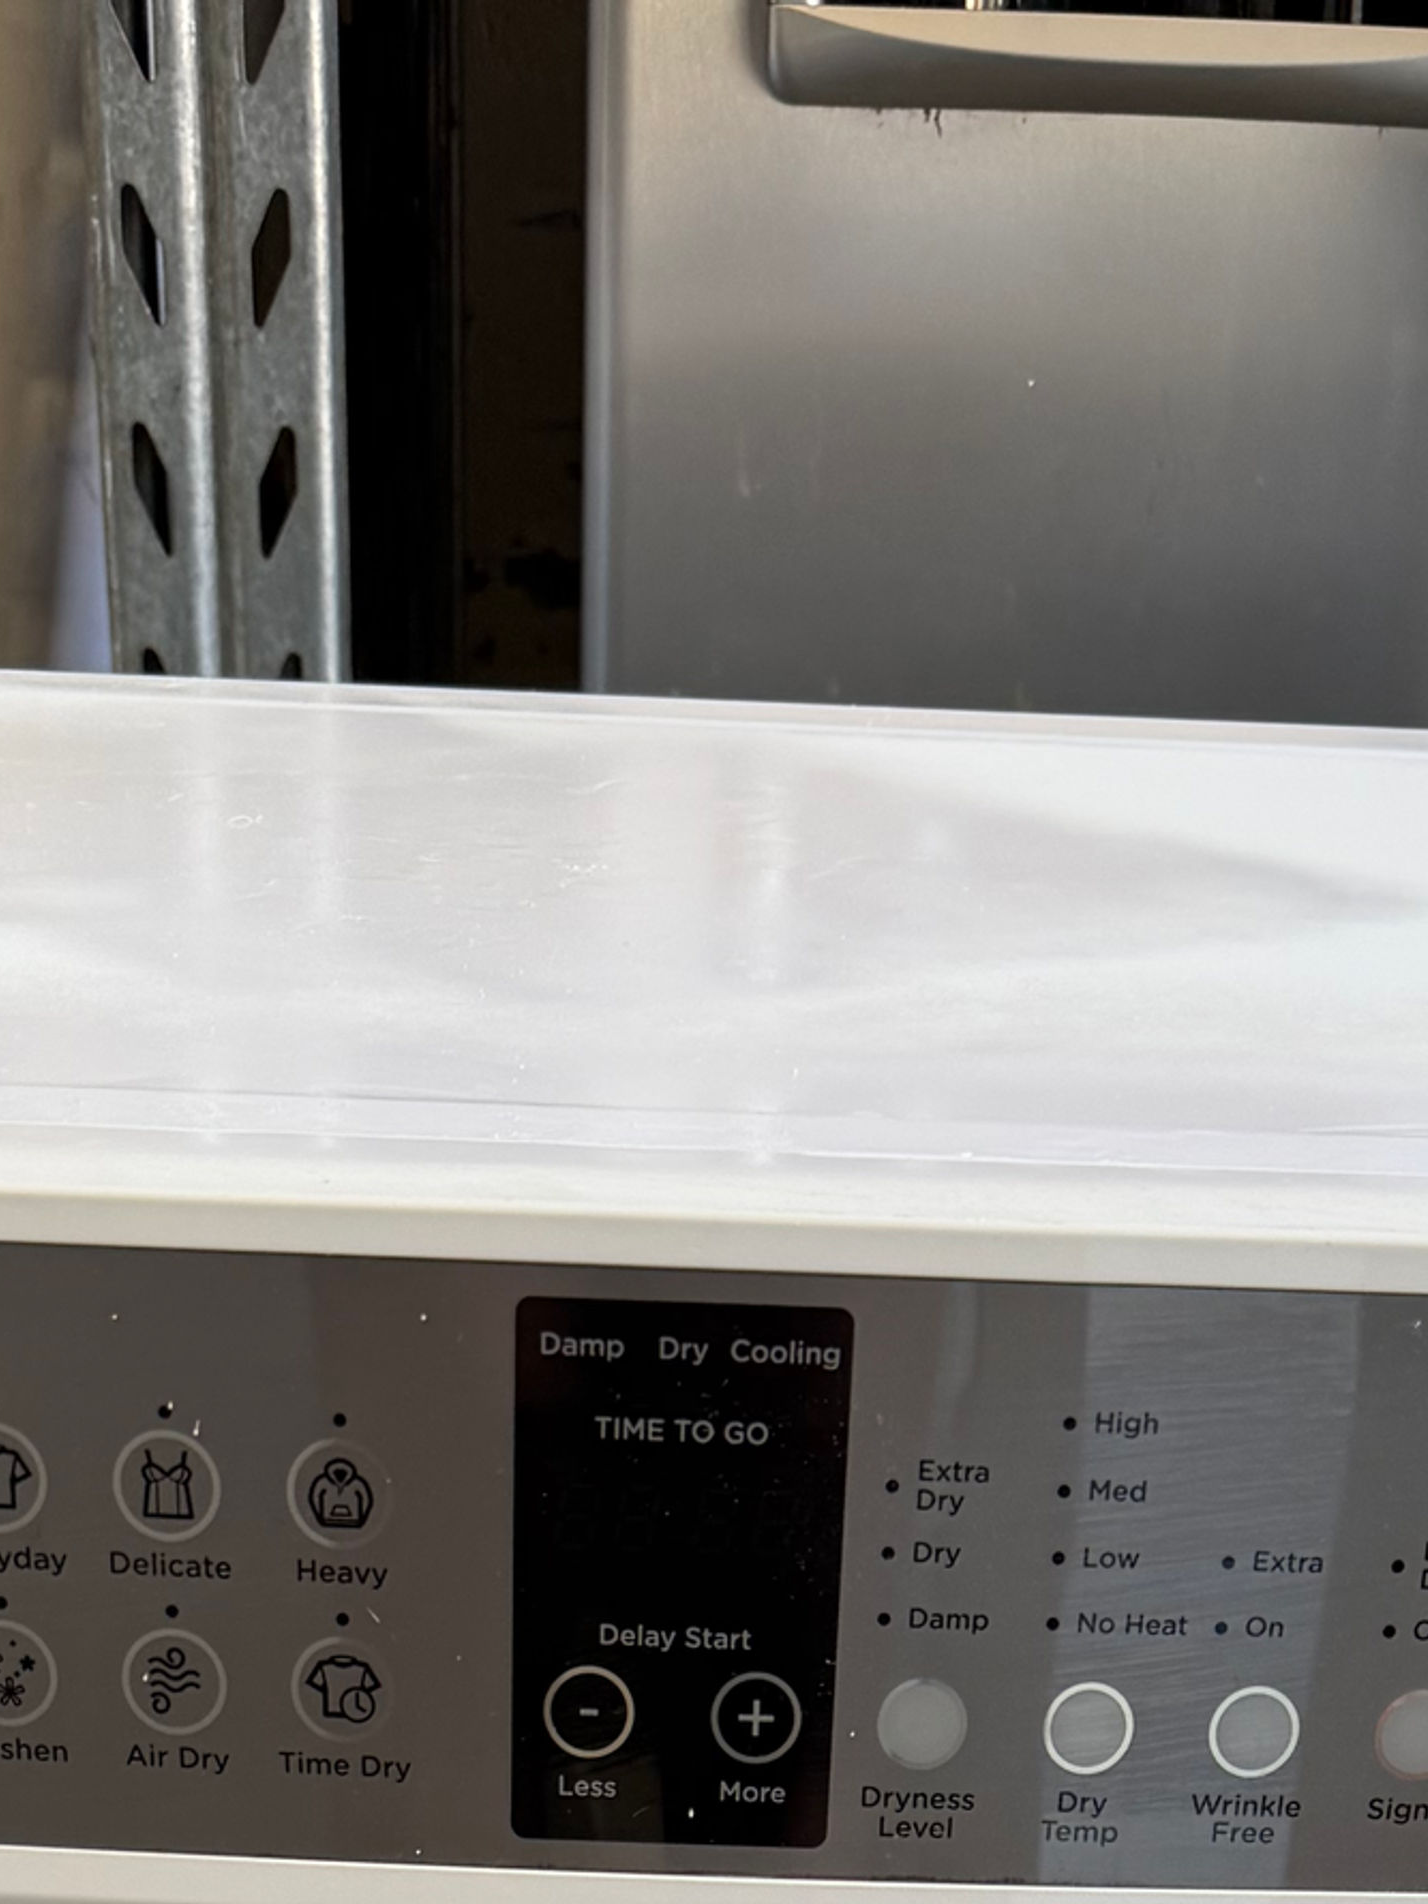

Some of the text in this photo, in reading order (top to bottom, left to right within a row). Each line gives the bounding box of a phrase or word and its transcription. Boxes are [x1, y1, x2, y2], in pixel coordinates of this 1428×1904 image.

[540, 1331, 842, 1370] Damp Dry Cooling
[594, 1415, 769, 1445] TIME TO GO
[1094, 1412, 1159, 1437] High
[918, 1460, 990, 1484] Extra
[916, 1489, 966, 1516] Dry
[1088, 1479, 1148, 1502] Med
[109, 1551, 232, 1581] Delicate
[912, 1541, 962, 1568] Dry
[1082, 1547, 1140, 1569] Low
[1252, 1552, 1324, 1574] Extra
[296, 1559, 389, 1590] Heavy
[908, 1608, 990, 1635] Damp
[1076, 1614, 1188, 1637] No Heat
[1245, 1617, 1285, 1638] On
[599, 1623, 752, 1654] Delay Start
[126, 1745, 230, 1776] Air Dry
[279, 1751, 412, 1783] Time Dry
[558, 1774, 617, 1799] Less
[719, 1781, 786, 1805] More
[861, 1786, 976, 1815] Dryness
[1057, 1791, 1107, 1818] Dry
[1191, 1793, 1301, 1820] Wrinkle
[878, 1816, 955, 1840] Level
[1040, 1819, 1119, 1847] Temp
[1210, 1821, 1275, 1844] Free
